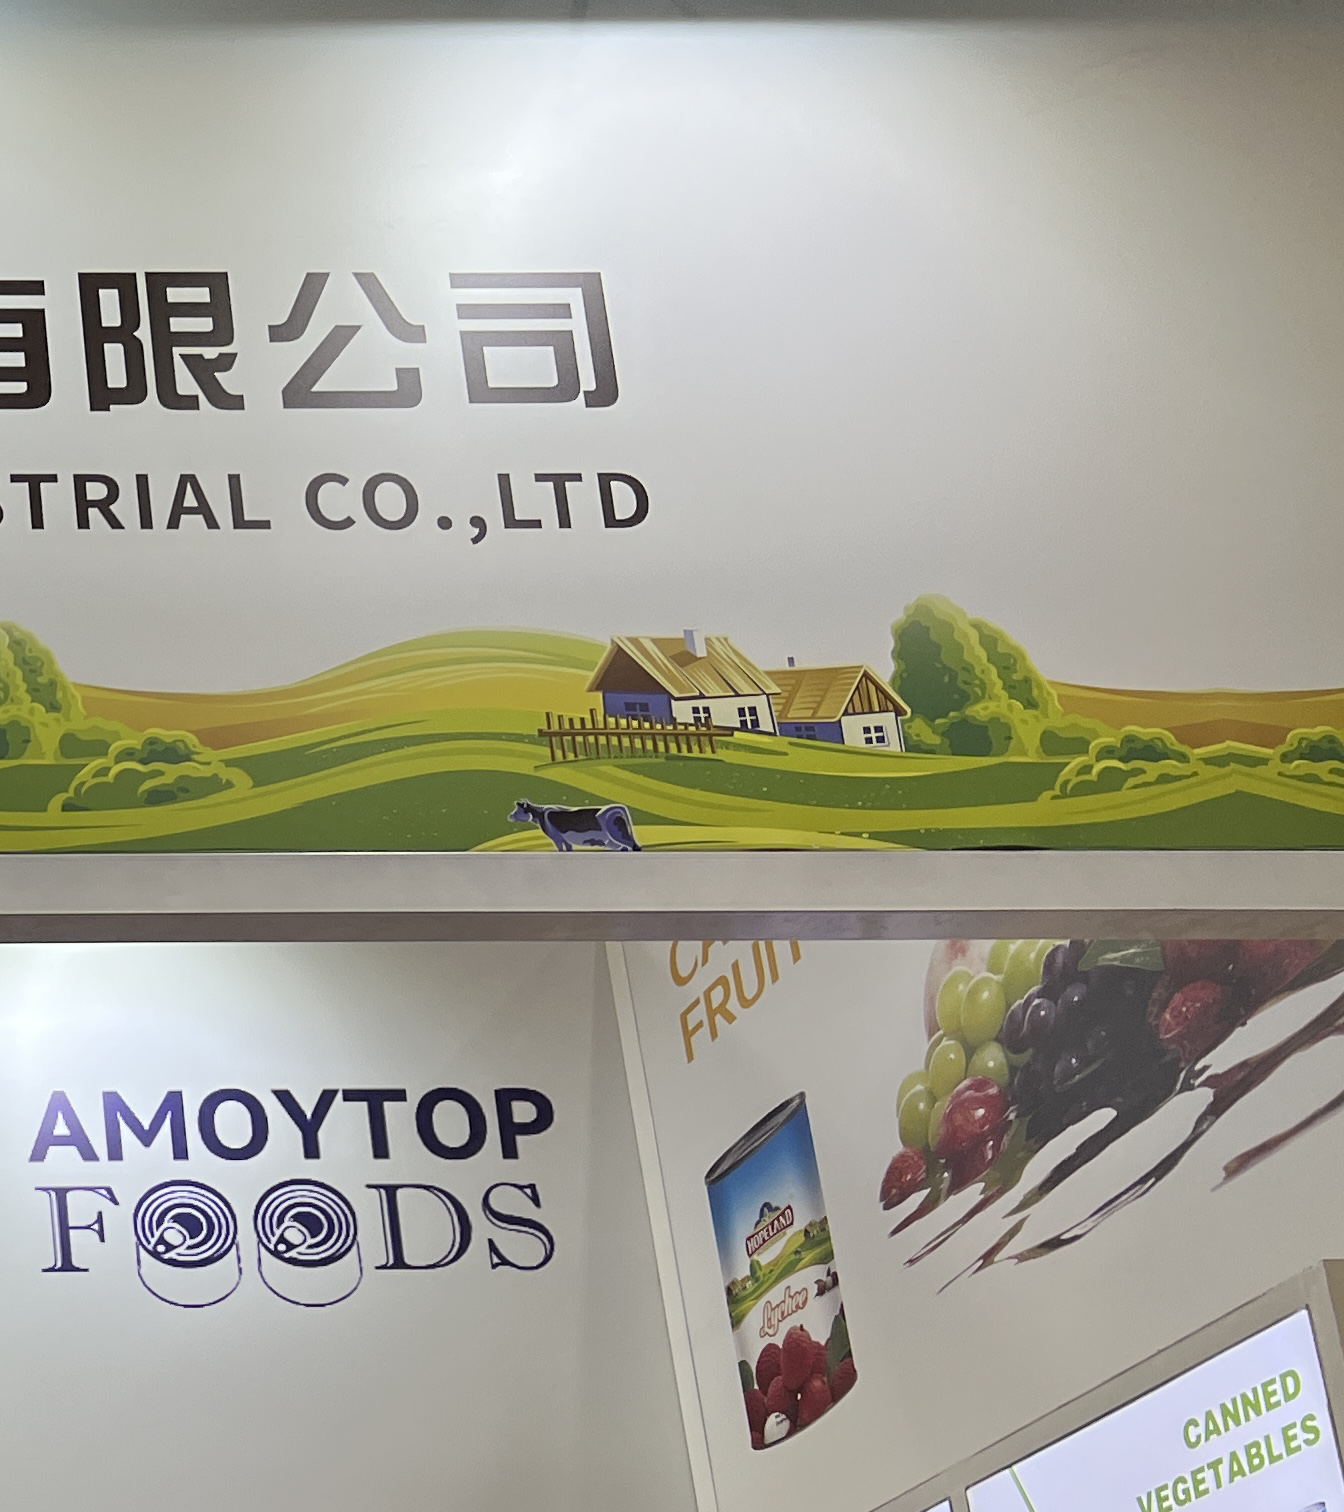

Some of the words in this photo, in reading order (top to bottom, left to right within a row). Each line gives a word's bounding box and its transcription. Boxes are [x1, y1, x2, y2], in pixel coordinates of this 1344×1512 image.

[28, 1086, 556, 1163] AMOYTOP
[35, 1178, 556, 1308] FOODS
[746, 1208, 793, 1253] HOPELAND
[759, 1285, 809, 1338] Lychee
[1182, 1368, 1303, 1451] CANNED
